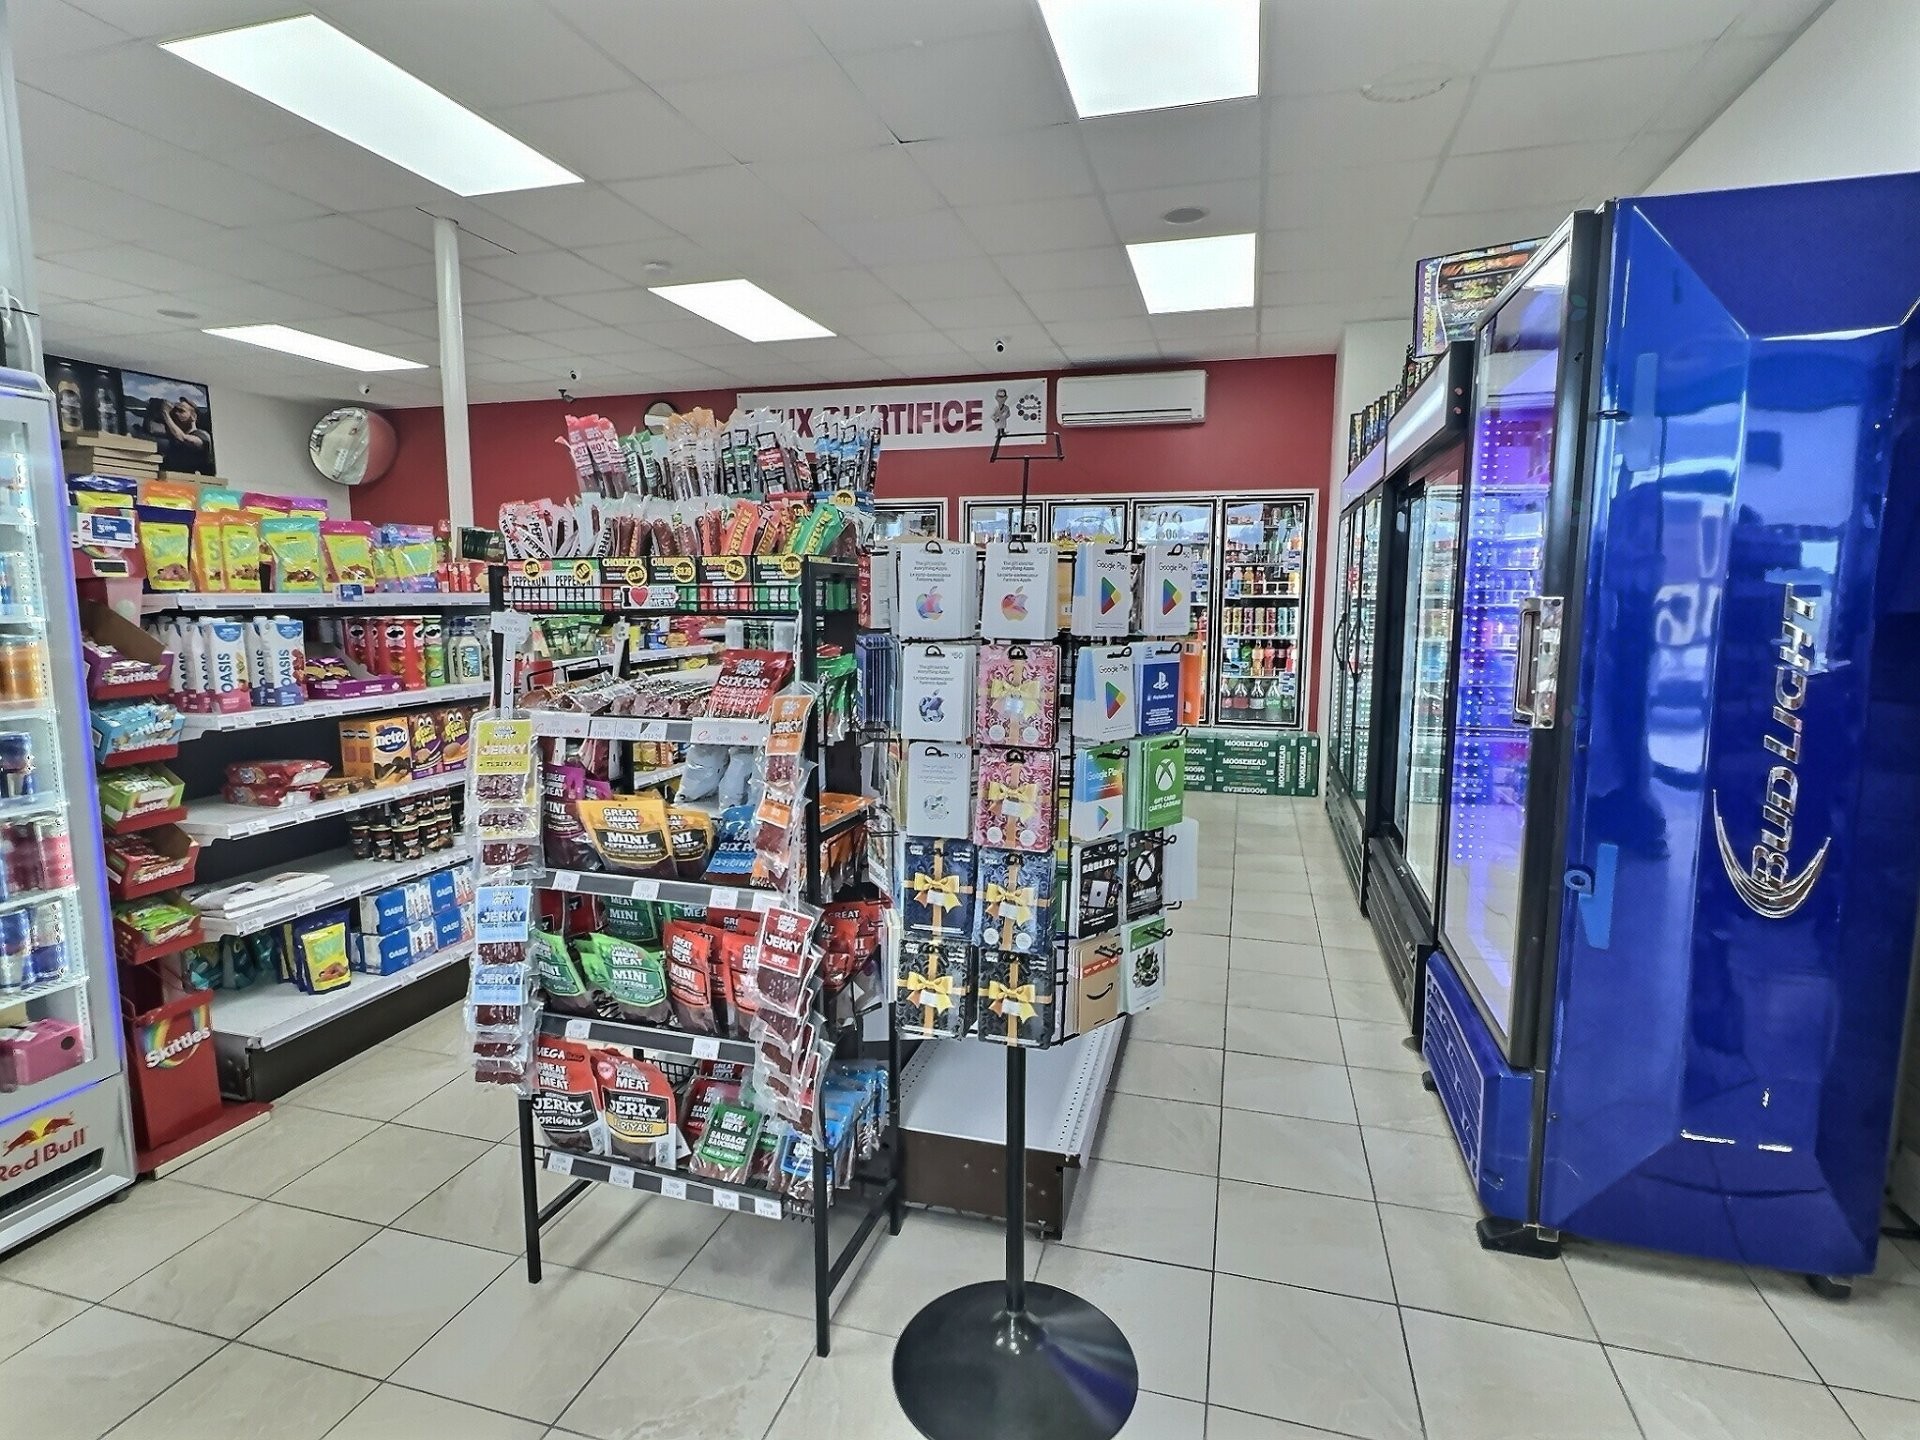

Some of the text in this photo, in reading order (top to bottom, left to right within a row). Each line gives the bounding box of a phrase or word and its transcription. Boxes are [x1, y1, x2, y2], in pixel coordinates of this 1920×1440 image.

[217, 652, 234, 693] OASIS
[281, 649, 291, 688] OASIS
[110, 671, 159, 686] Skittles
[1752, 582, 1816, 886] BUD LIGHT
[480, 743, 527, 755] JERKY
[1224, 739, 1270, 748] MOOSEHEAD
[1222, 757, 1267, 766] MOOSEHEAD
[603, 807, 639, 816] GREAT
[608, 821, 641, 830] MEAT
[606, 831, 650, 844] MINI
[480, 910, 524, 923] JERKY
[609, 908, 639, 921] MINI
[765, 932, 802, 953] JERKY
[478, 972, 520, 985] JERKY
[612, 969, 648, 983] MINI
[144, 1025, 212, 1069] Skittles
[539, 1076, 570, 1091] MEAT
[616, 1077, 650, 1092] MEAT
[532, 1098, 584, 1113] JERKY
[609, 1099, 661, 1118] JERKY
[538, 1116, 583, 1126] ORIGINAL
[721, 1122, 743, 1133] MEAT
[43, 1128, 84, 1161] Bull
